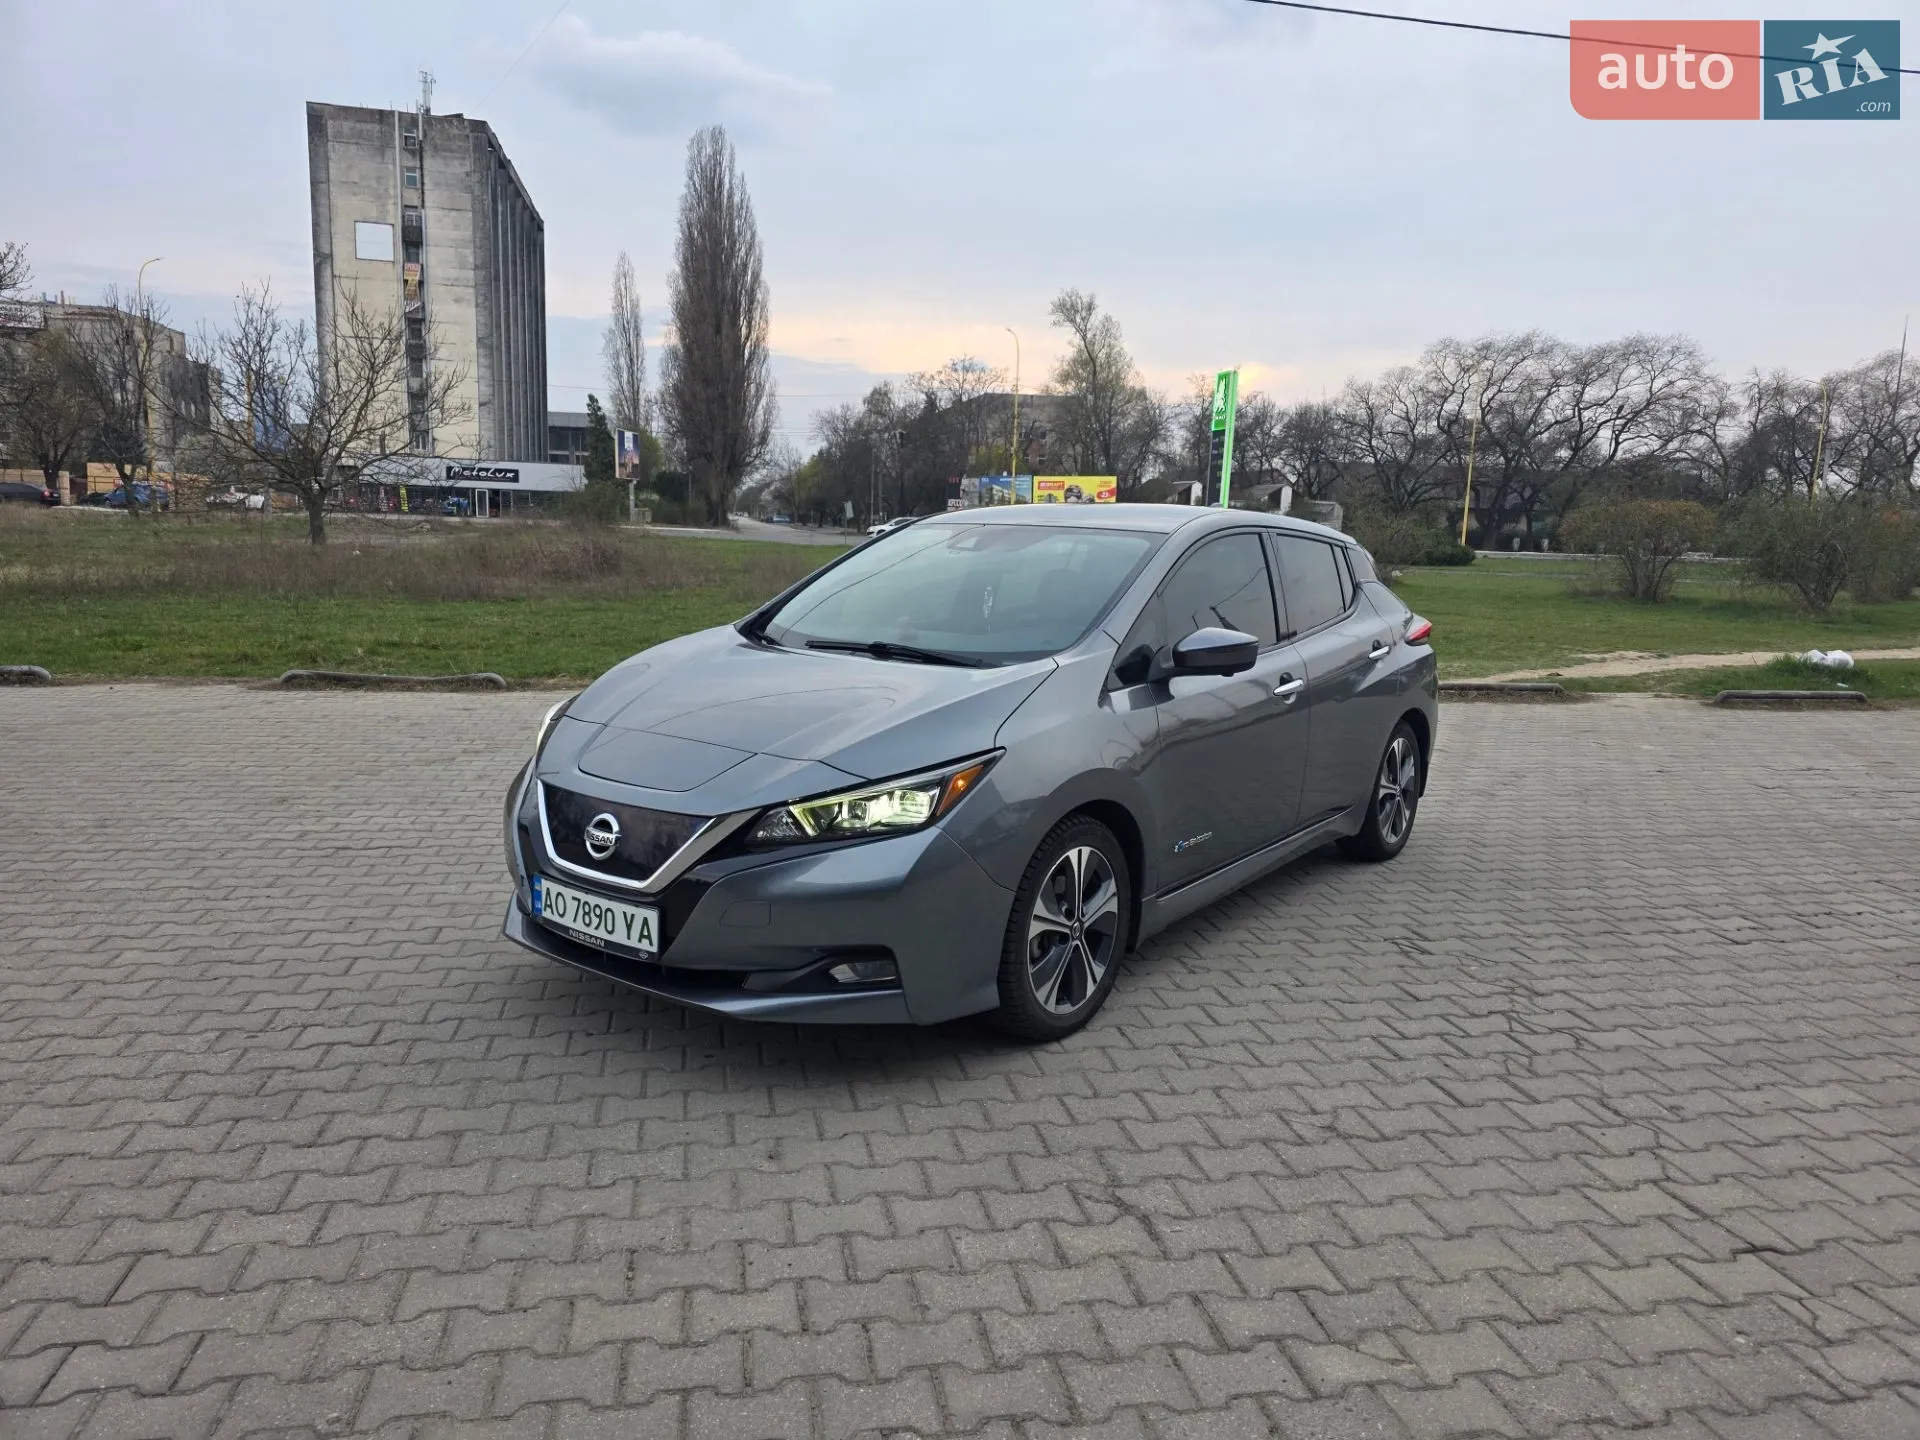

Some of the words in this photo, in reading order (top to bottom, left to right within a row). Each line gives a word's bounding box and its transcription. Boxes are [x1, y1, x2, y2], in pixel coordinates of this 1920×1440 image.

[543, 887, 566, 918] AO
[572, 896, 615, 935] 7890
[622, 911, 653, 947] YA
[569, 929, 605, 947] NISSAN
